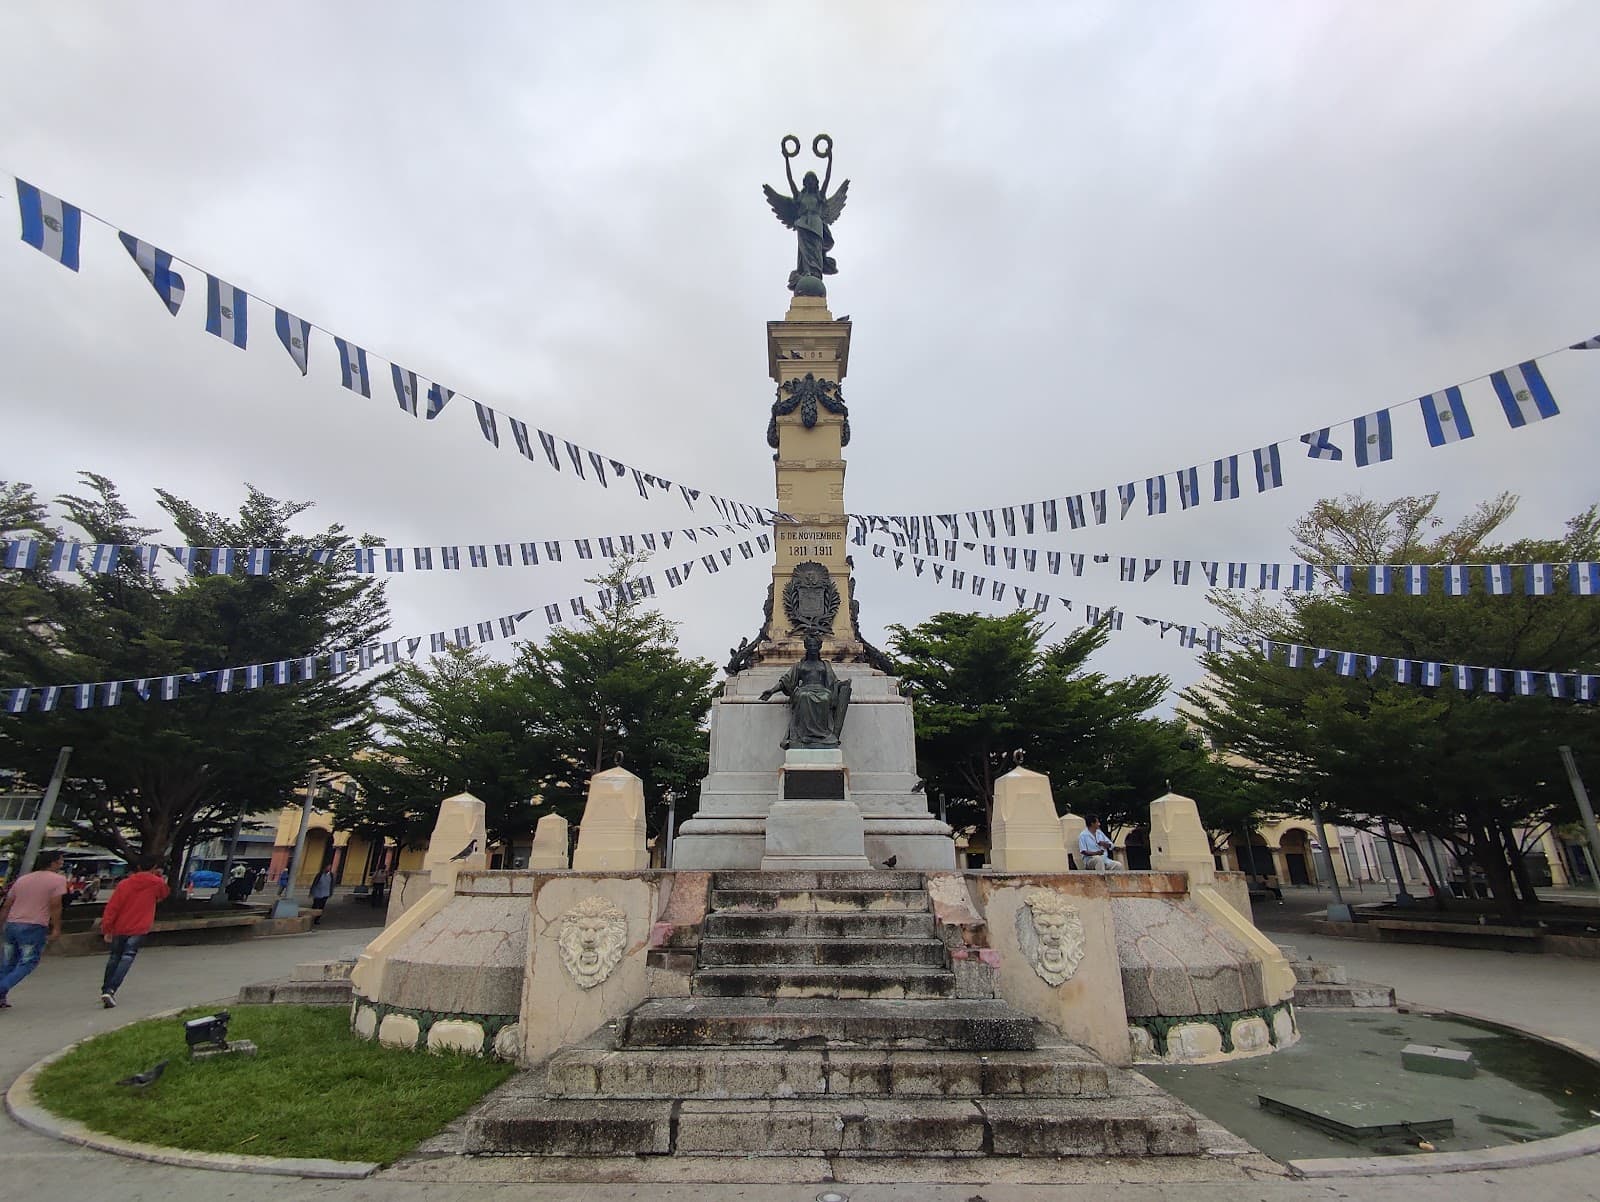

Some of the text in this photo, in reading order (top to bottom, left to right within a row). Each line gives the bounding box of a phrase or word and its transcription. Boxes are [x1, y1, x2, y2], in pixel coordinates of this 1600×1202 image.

[780, 531, 842, 540] 5 DE NOVIEMBRE
[789, 546, 832, 556] 1811 1911
